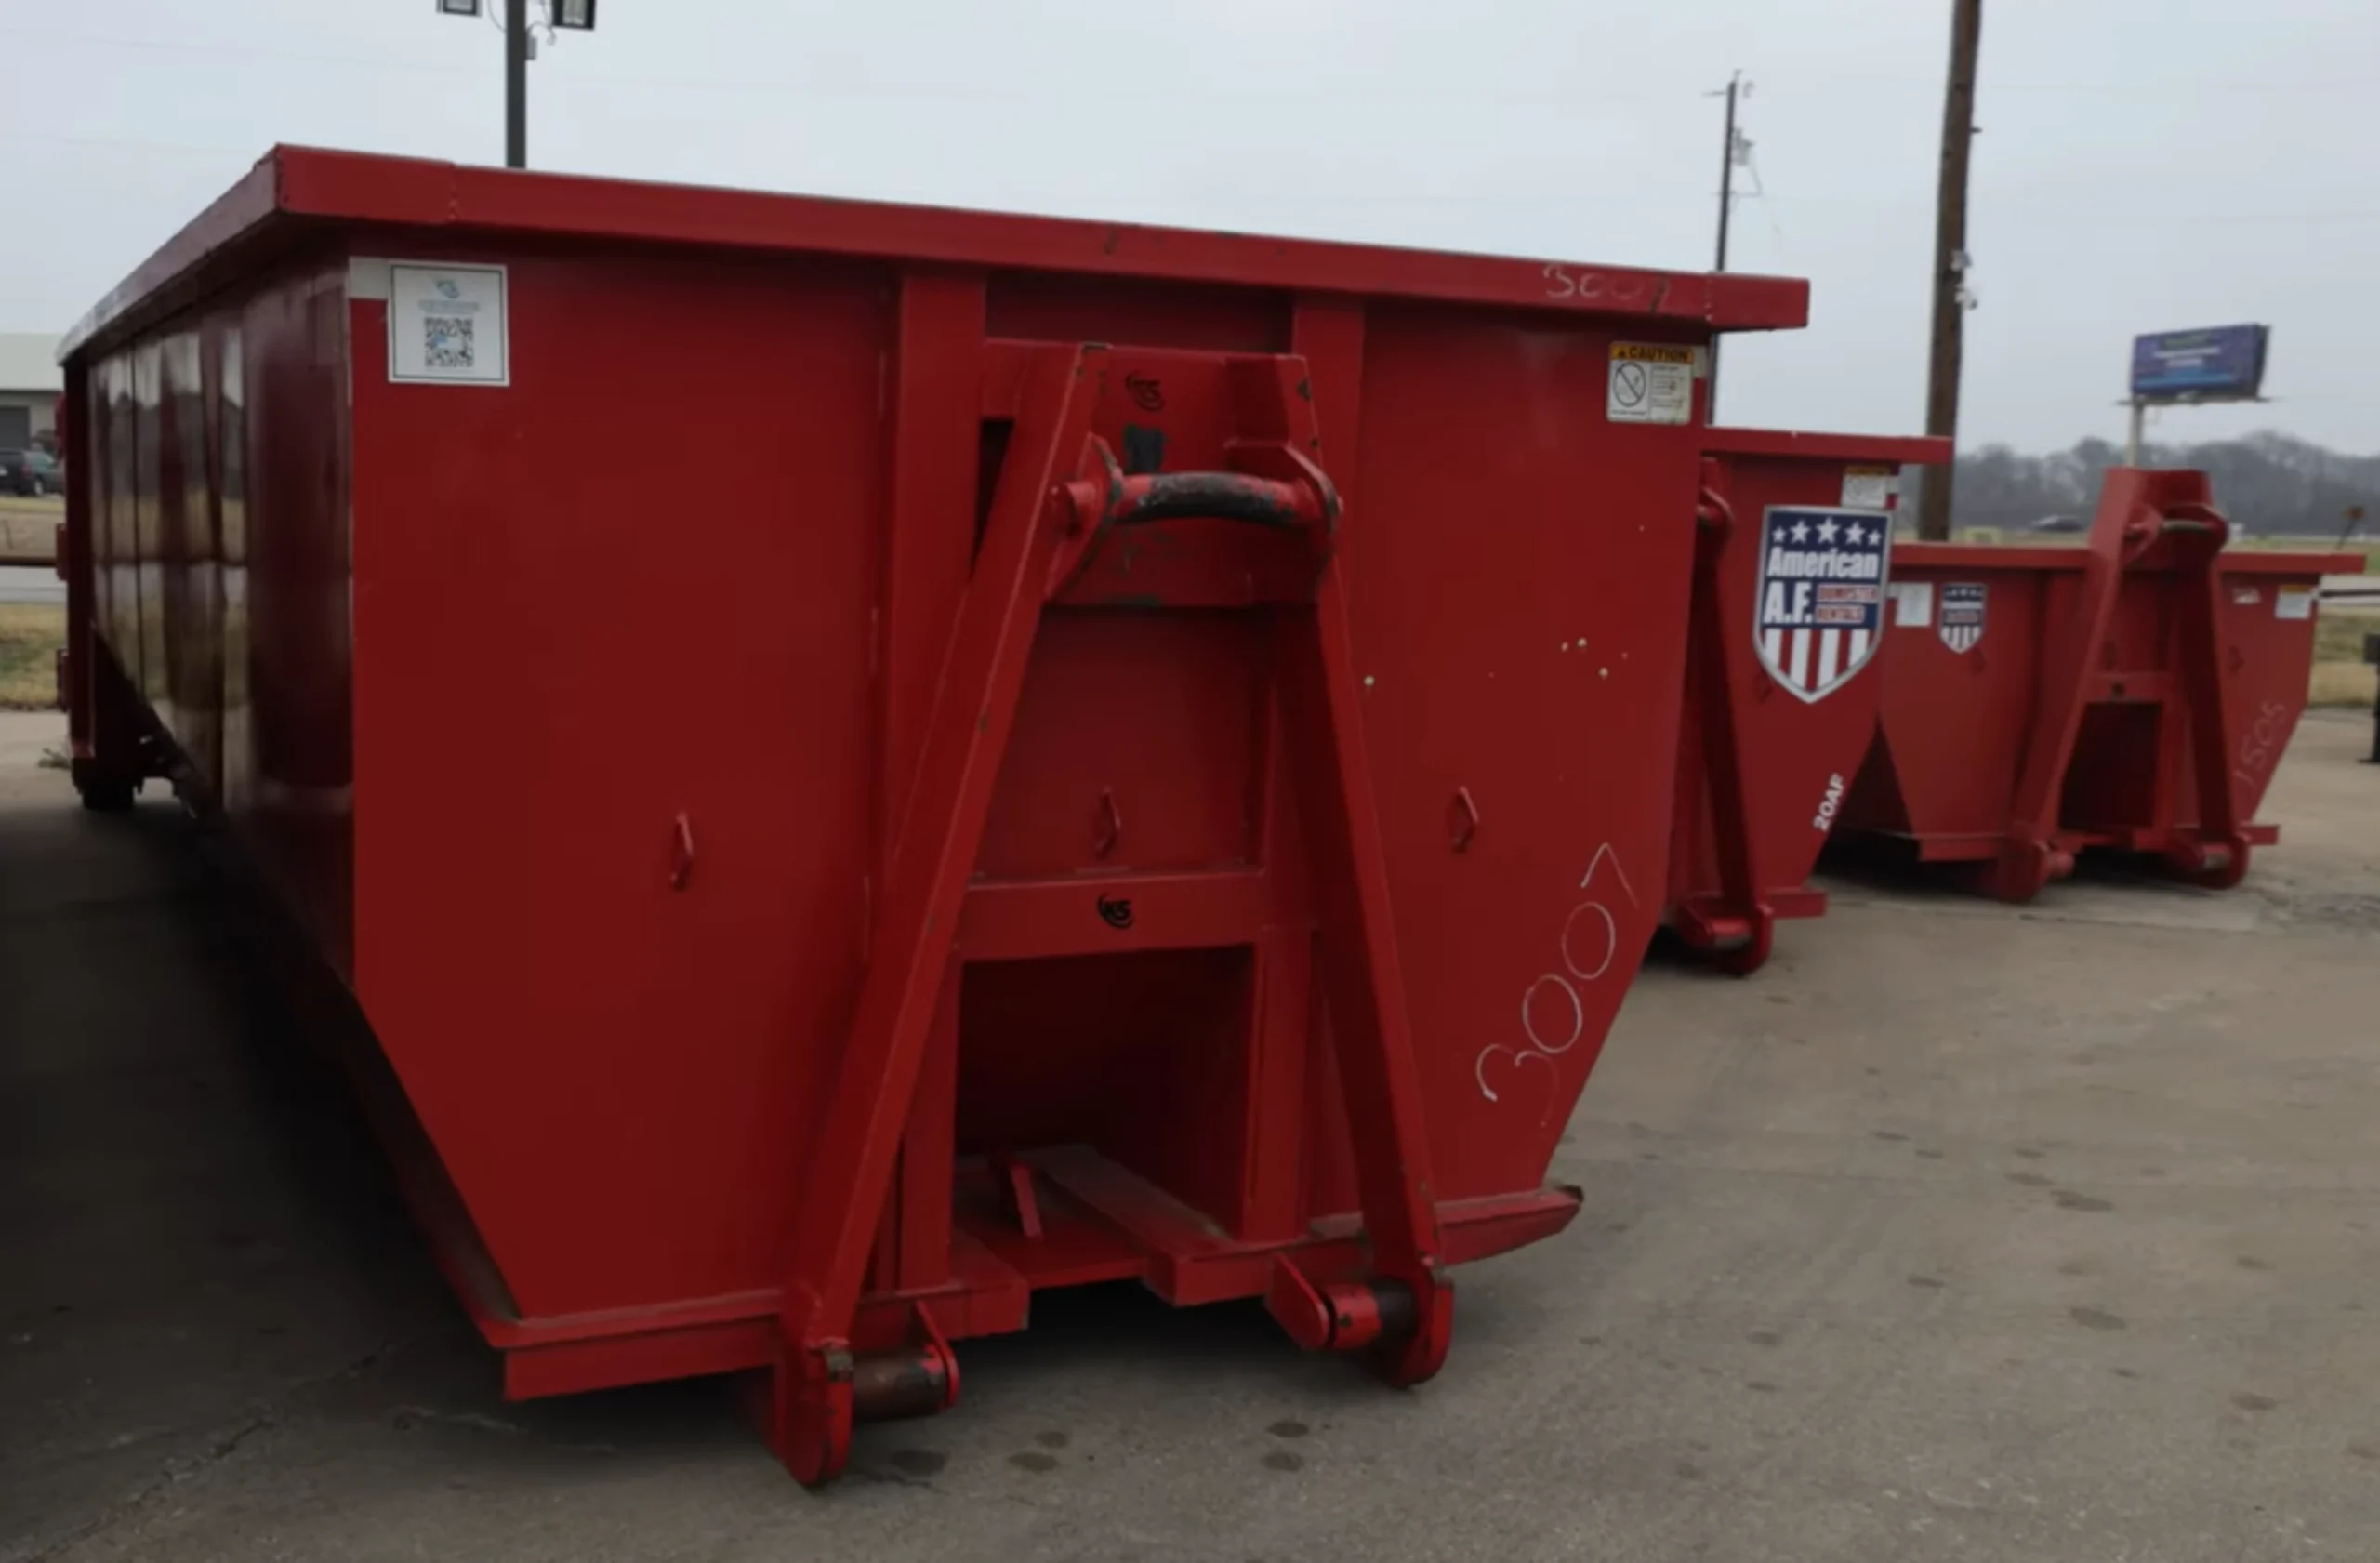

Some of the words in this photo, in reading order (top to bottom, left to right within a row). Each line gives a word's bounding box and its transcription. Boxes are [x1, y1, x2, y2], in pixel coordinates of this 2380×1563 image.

[1629, 347, 1688, 363] CAUTION
[1766, 546, 1879, 578] American
[1764, 581, 1812, 624] A.F.
[1475, 842, 1640, 1128] 3007
